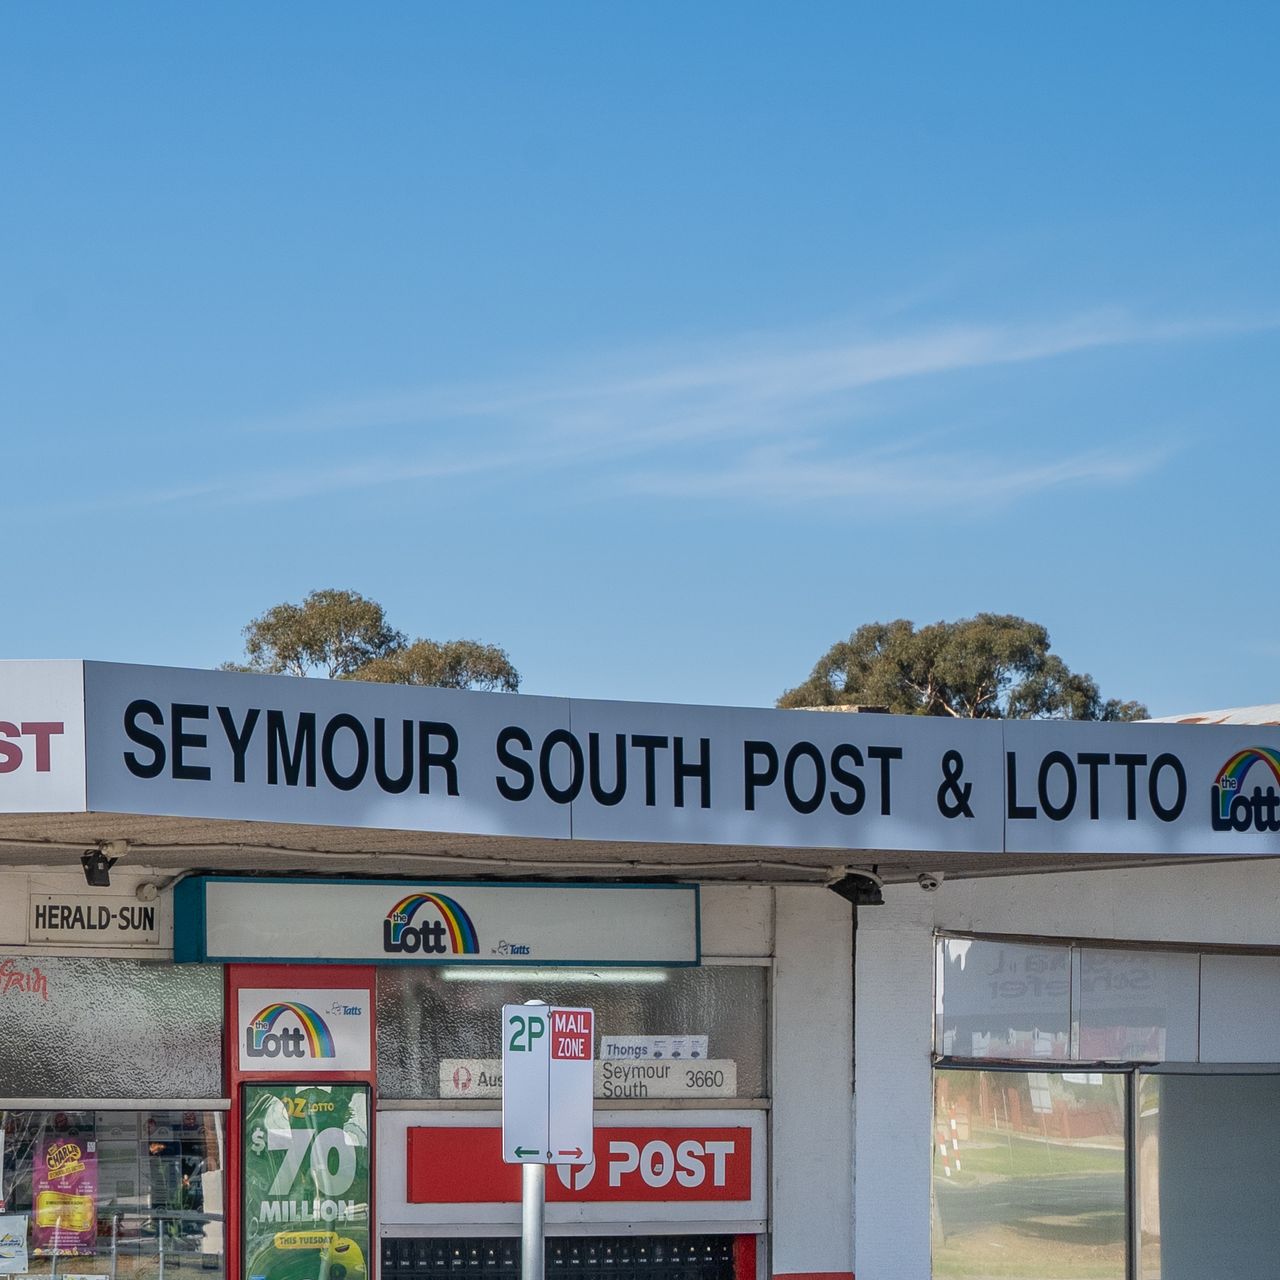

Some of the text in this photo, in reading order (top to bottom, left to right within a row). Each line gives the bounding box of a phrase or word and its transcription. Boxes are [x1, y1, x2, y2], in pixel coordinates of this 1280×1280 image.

[123, 698, 1188, 822] SEYMOUR SOUTH POST & LOTTO
[1221, 774, 1237, 789] the
[1211, 784, 1280, 832] Lott
[35, 903, 156, 932] HERALD-SUN
[393, 912, 408, 923] the
[384, 919, 447, 954] Lott
[509, 943, 530, 955] Tatts
[343, 1005, 362, 1016] Tatts
[255, 1020, 268, 1030] the
[508, 1015, 545, 1052] 2P
[555, 1013, 589, 1034] MAIL
[246, 1026, 306, 1058] Lott
[557, 1037, 585, 1058] ZONE
[607, 1044, 648, 1059] Thongs
[602, 1062, 671, 1083] Seymour
[685, 1070, 724, 1088] 3660
[602, 1080, 649, 1098] South
[282, 1097, 334, 1119] OZ LOTTO
[608, 1140, 735, 1188] POST
[259, 1199, 355, 1223] MILLION
[279, 1235, 334, 1245] THIS TUESDAY
